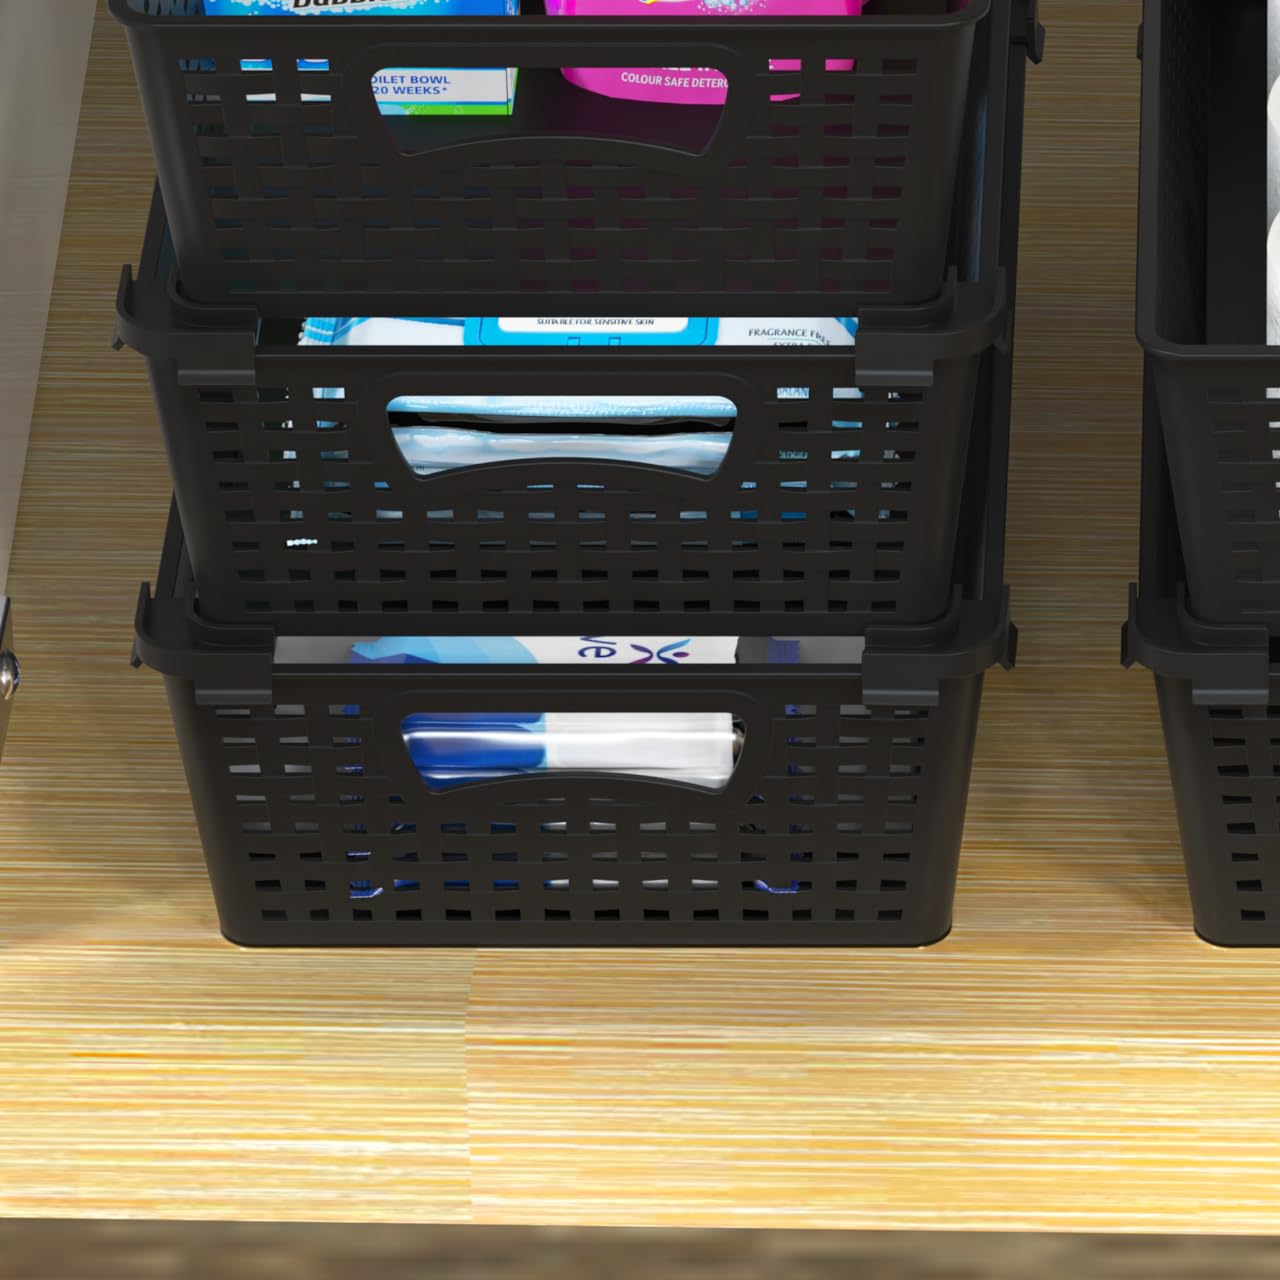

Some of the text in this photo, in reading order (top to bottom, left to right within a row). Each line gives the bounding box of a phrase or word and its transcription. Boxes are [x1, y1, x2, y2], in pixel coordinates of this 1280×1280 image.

[410, 75, 451, 84] BOWL
[621, 72, 662, 86] COLOUR
[664, 77, 690, 88] SAFE
[748, 328, 808, 337] FRAGRANCE
